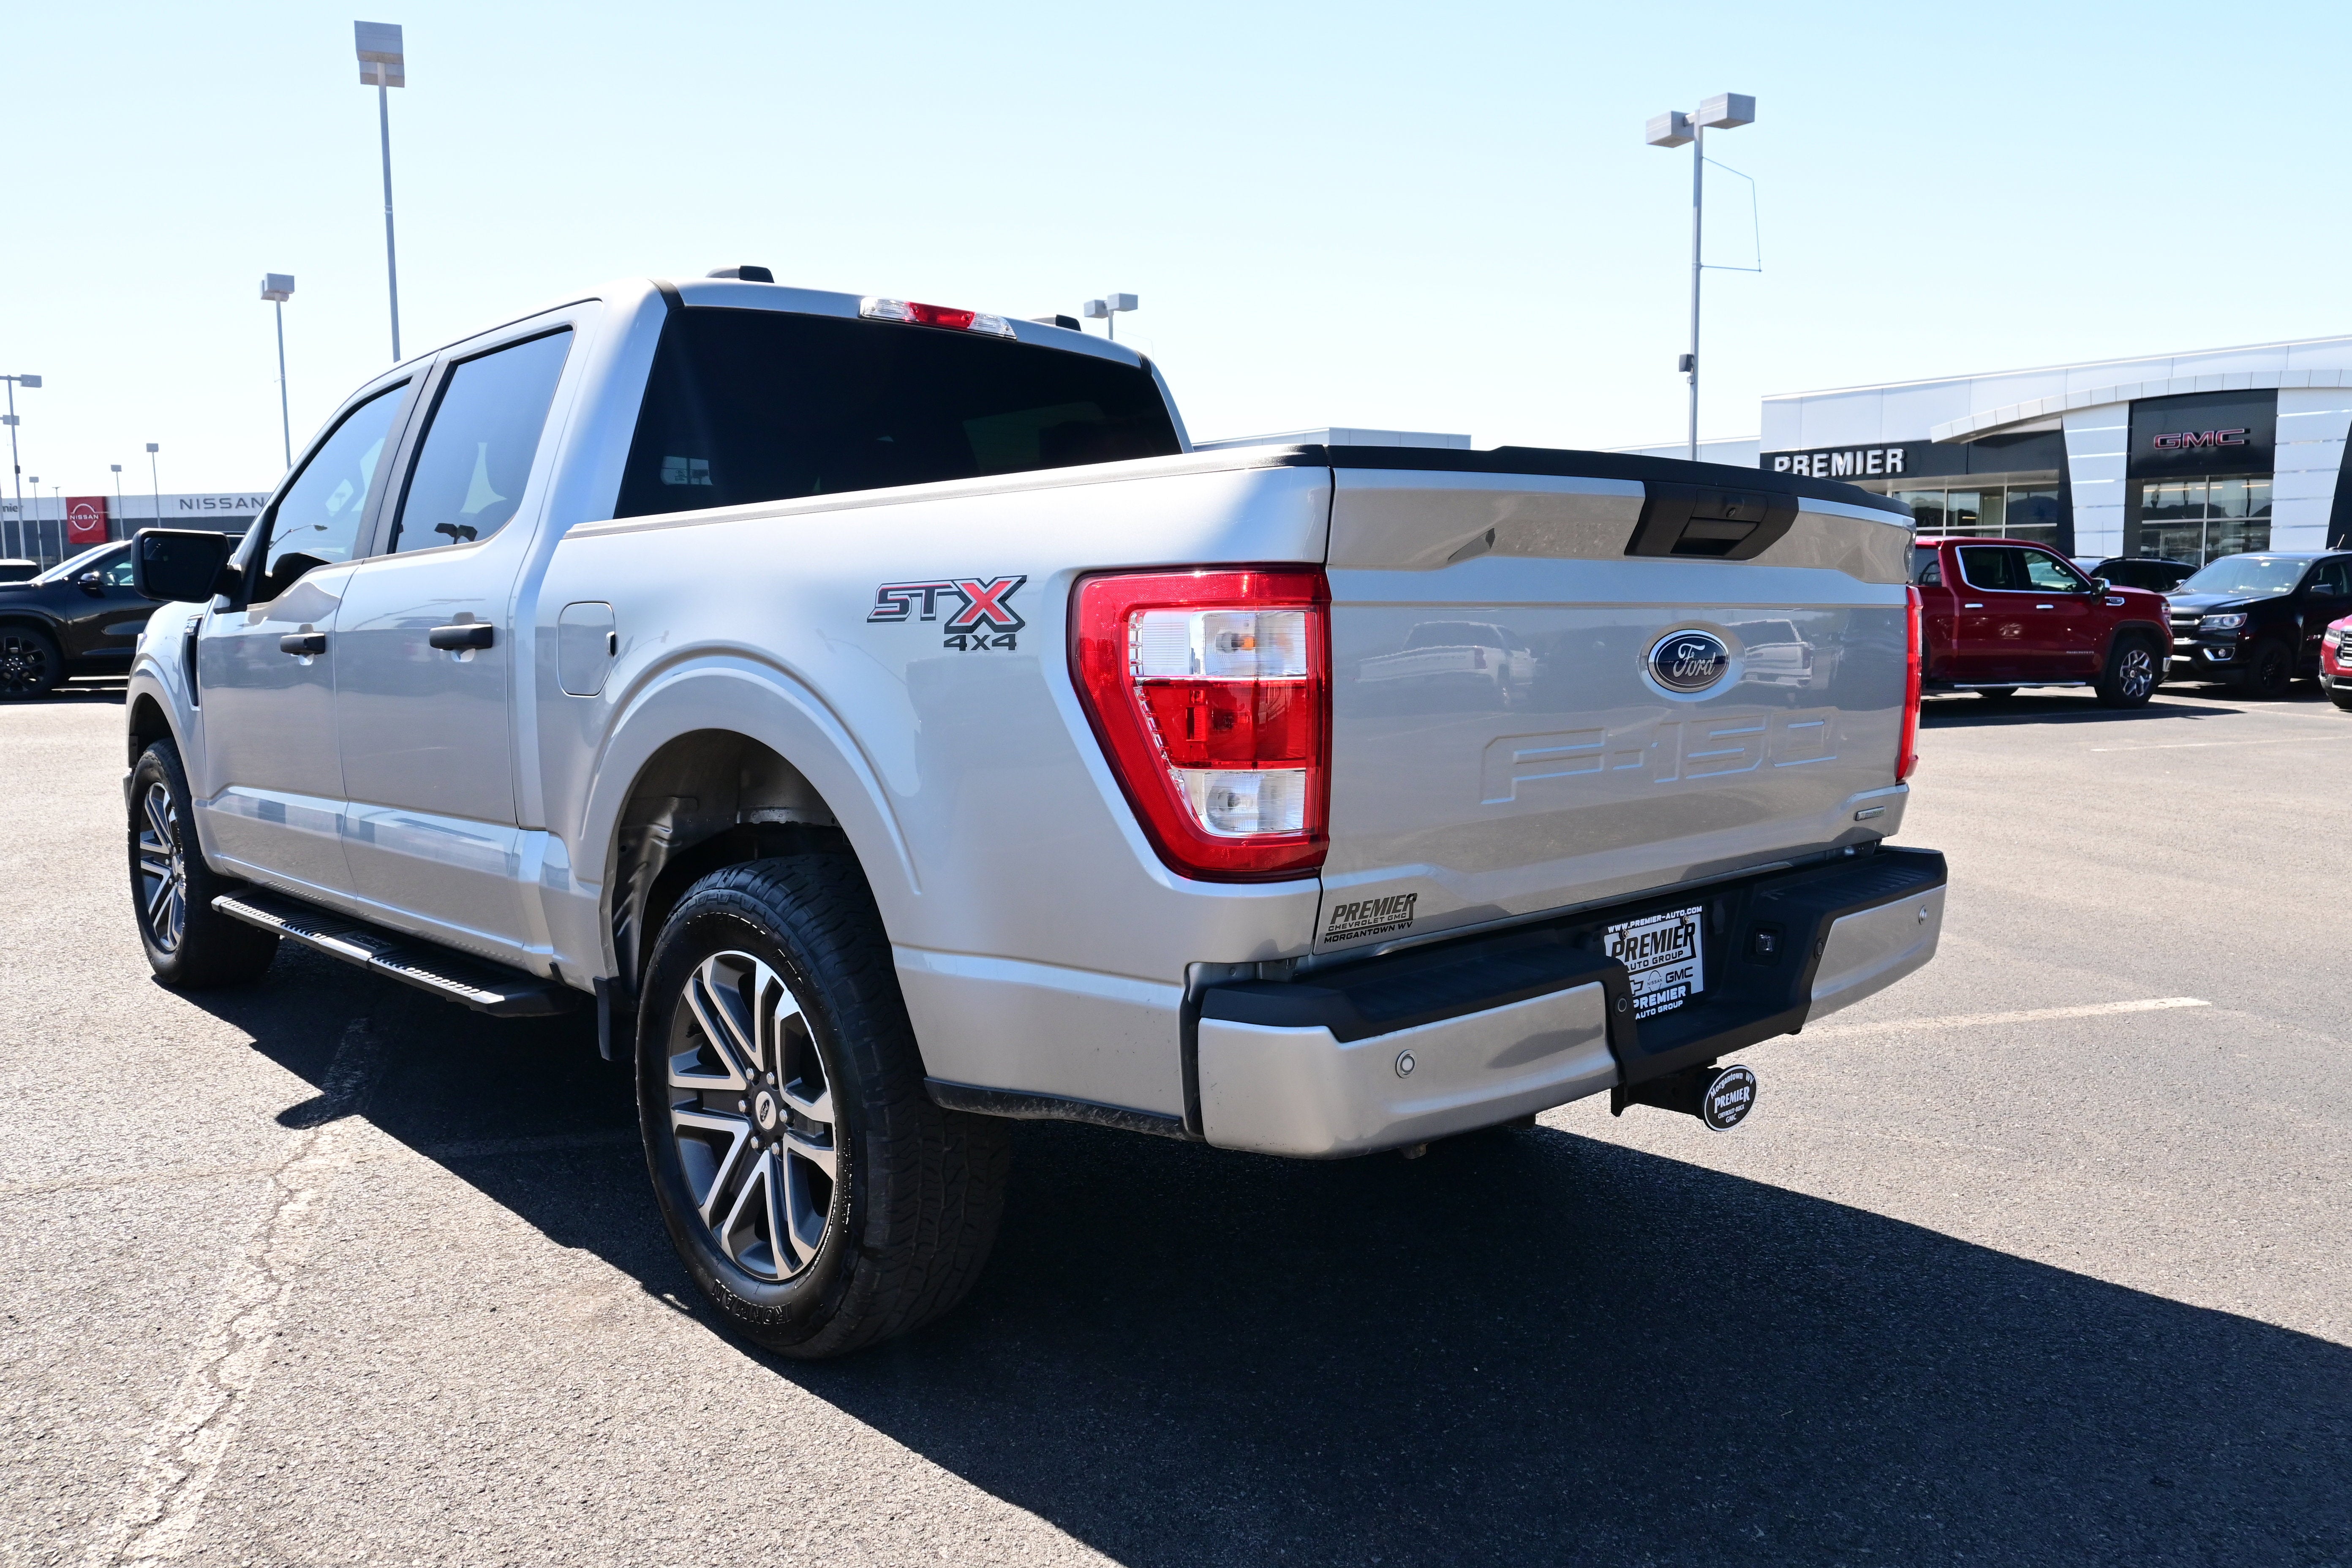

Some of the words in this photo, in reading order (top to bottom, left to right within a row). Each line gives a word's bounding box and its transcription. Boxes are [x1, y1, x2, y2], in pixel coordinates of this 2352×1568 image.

[2153, 428, 2245, 449] GMC
[1774, 448, 1905, 478] PREMIER
[180, 497, 264, 510] NISSAN
[867, 574, 1028, 634] STX
[1673, 643, 1716, 678] Ford
[1481, 706, 1840, 805] F-150
[1330, 893, 1418, 925] PREMIER
[1608, 906, 1702, 933] WWW.PREMIER-AUTO.COM
[1324, 925, 1395, 944] MORGANTOWN
[1398, 921, 1413, 930] WV
[1328, 915, 1385, 931] CHEVROLET
[1387, 913, 1407, 921] GMC
[1612, 922, 1696, 962] PREMIER
[1652, 950, 1684, 964] GROUP
[1647, 978, 1663, 986] NISSAN
[1666, 966, 1693, 984] GMC
[1633, 985, 1686, 1009] PREMIER
[1636, 1007, 1656, 1020] AUTO
[1658, 1000, 1683, 1013] GROUP
[1710, 1073, 1743, 1100] Morgantown
[1745, 1072, 1754, 1085] WV
[1714, 1086, 1750, 1113] PREMIER
[1726, 1113, 1737, 1123] GMC
[710, 1279, 792, 1325] IRONMAN
